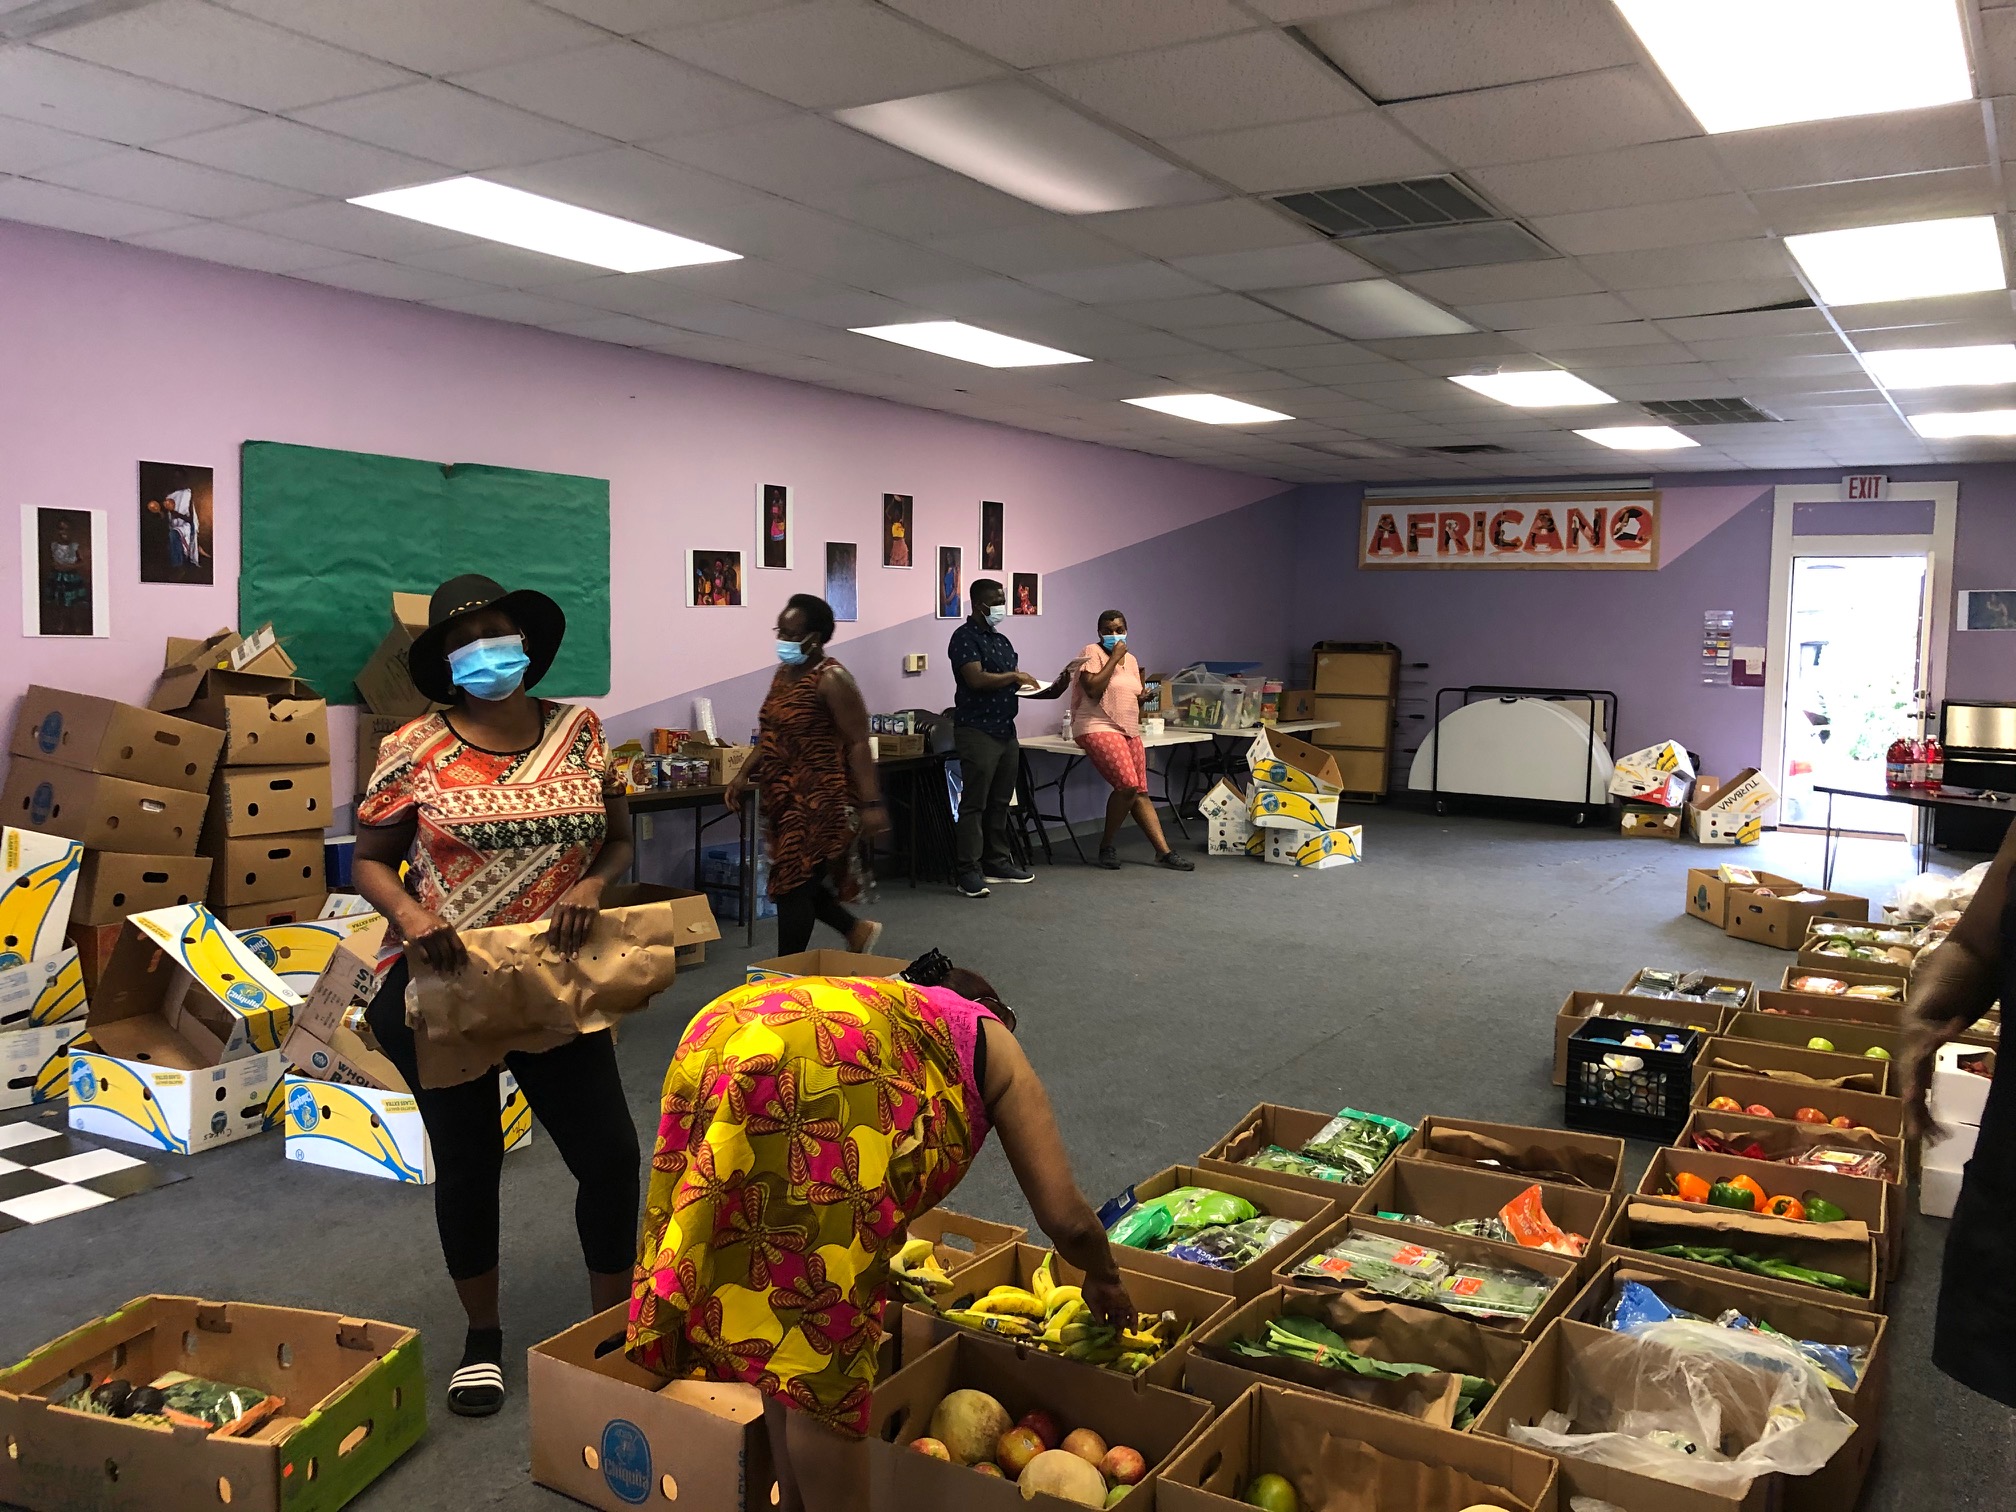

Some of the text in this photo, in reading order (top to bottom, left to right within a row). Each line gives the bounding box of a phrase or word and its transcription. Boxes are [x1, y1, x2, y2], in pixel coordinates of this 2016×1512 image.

[1849, 477, 1881, 499] EXIT
[1367, 505, 1653, 556] AFRICANO
[1718, 779, 1760, 810] TURBANA
[227, 989, 260, 1009] Chiquita
[604, 1457, 649, 1490] Chiquita
